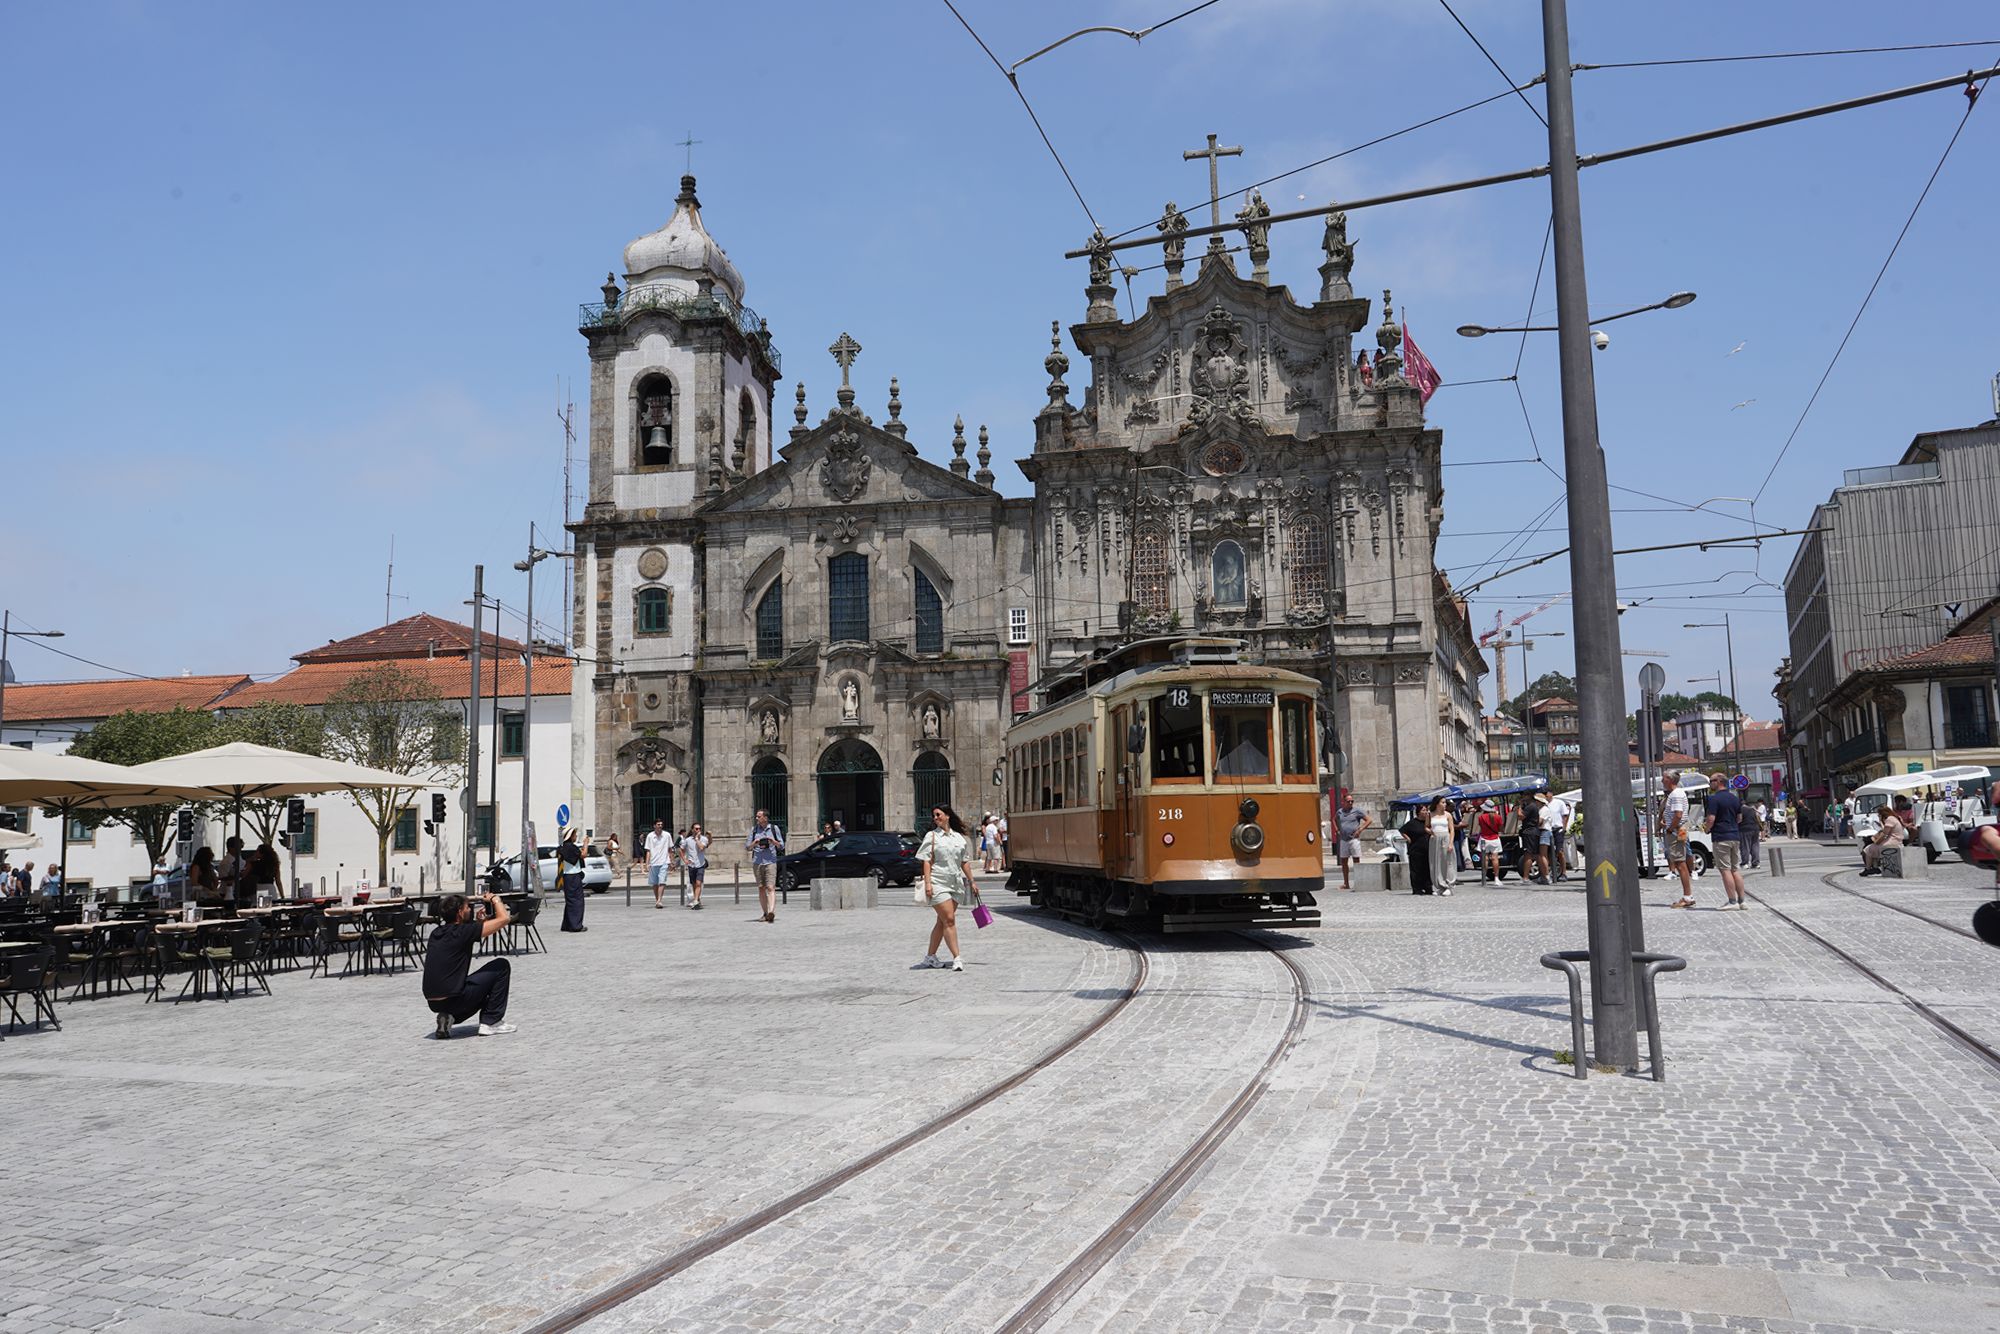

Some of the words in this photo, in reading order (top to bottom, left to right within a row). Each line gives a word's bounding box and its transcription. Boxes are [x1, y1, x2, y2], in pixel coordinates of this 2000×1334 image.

[1170, 689, 1188, 706] 18
[1212, 693, 1242, 704] PASSEIO
[1243, 693, 1272, 704] ALEGRE
[1158, 808, 1183, 820] 218
